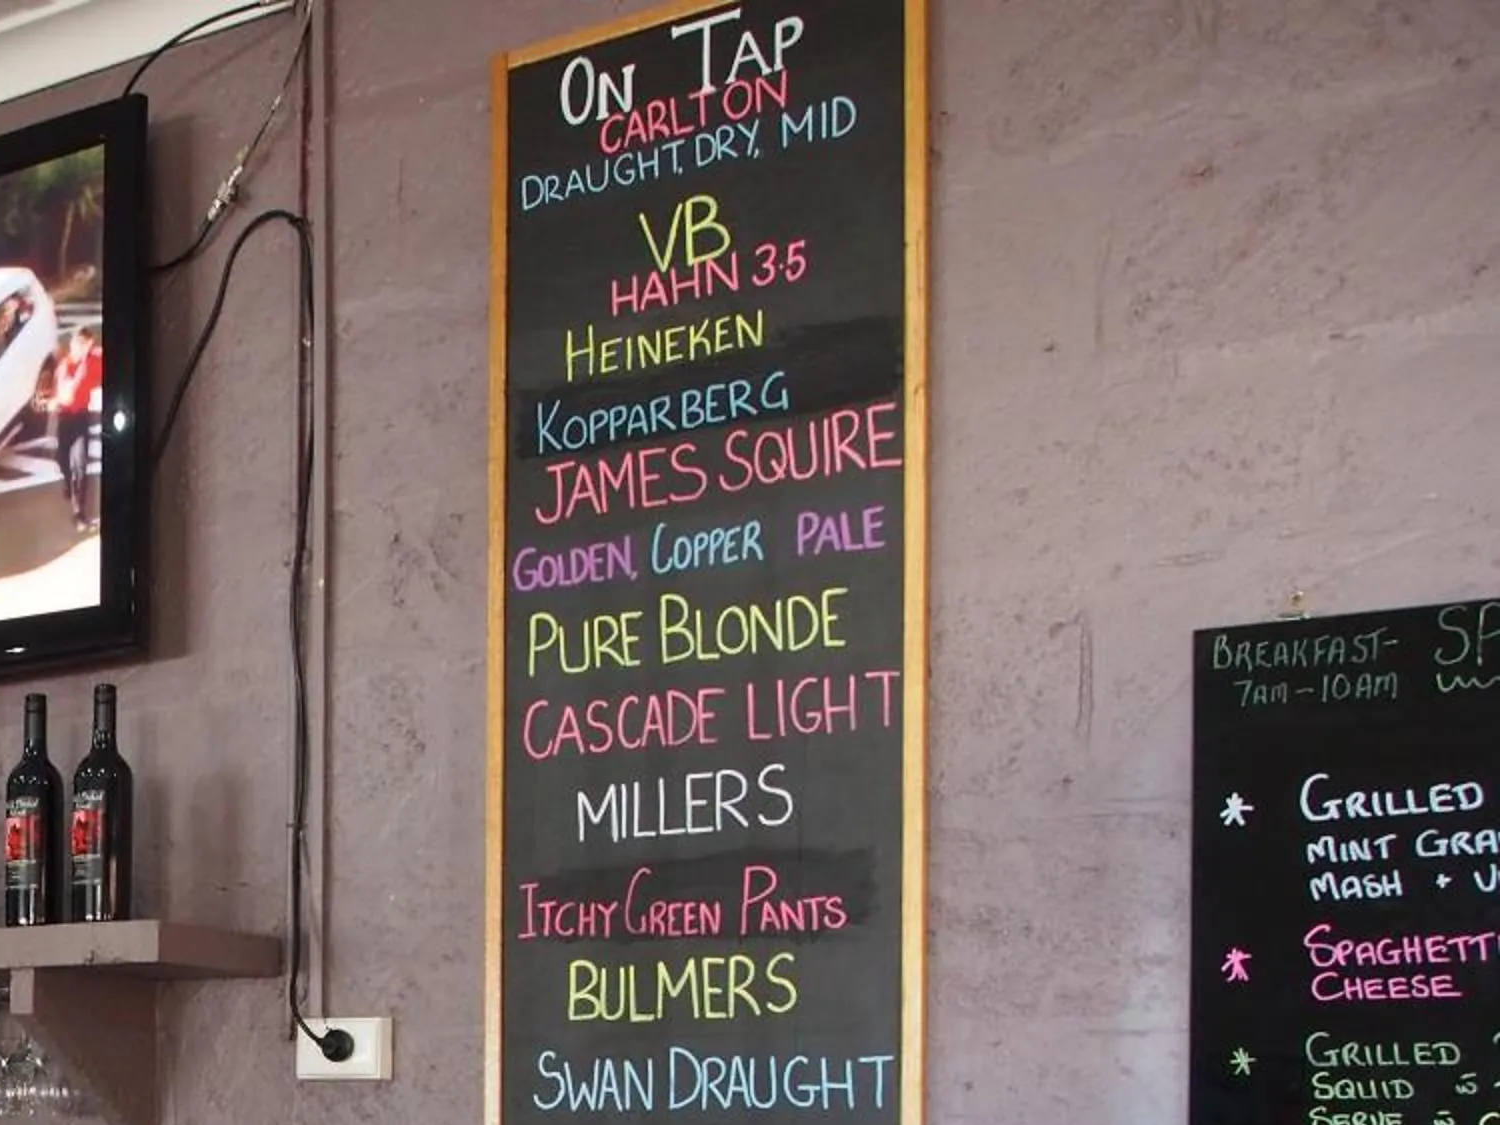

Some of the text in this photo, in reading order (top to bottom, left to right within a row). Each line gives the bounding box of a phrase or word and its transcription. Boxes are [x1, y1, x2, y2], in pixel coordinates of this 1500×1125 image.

[560, 8, 804, 126] ON TAP
[599, 70, 789, 154] CARLTON
[781, 96, 857, 148] MID
[639, 194, 731, 273] VB
[610, 251, 739, 317] HAHN
[566, 310, 764, 383] HEINEKEN
[536, 371, 789, 454] KOPPARBERG
[534, 402, 904, 524] JAMES SQUIRE
[651, 519, 764, 574] COPPER
[796, 506, 886, 557] PALE
[528, 587, 848, 677] PURE BLONDE
[523, 671, 901, 760] CASCADE LIGHT
[577, 763, 794, 843] MILLERS
[1300, 773, 1484, 822] GRILLED
[1307, 829, 1500, 865] MINT GRA
[518, 864, 848, 940] ITCHY GREEN PANTS
[1310, 869, 1403, 902] MASH
[568, 951, 798, 1023] BULMERS
[1312, 971, 1462, 1001] CHEESE
[532, 1046, 894, 1112] SWAN DRAUGHT
[1306, 1031, 1461, 1067] GRILLED
[1312, 1071, 1414, 1100] SQUID
